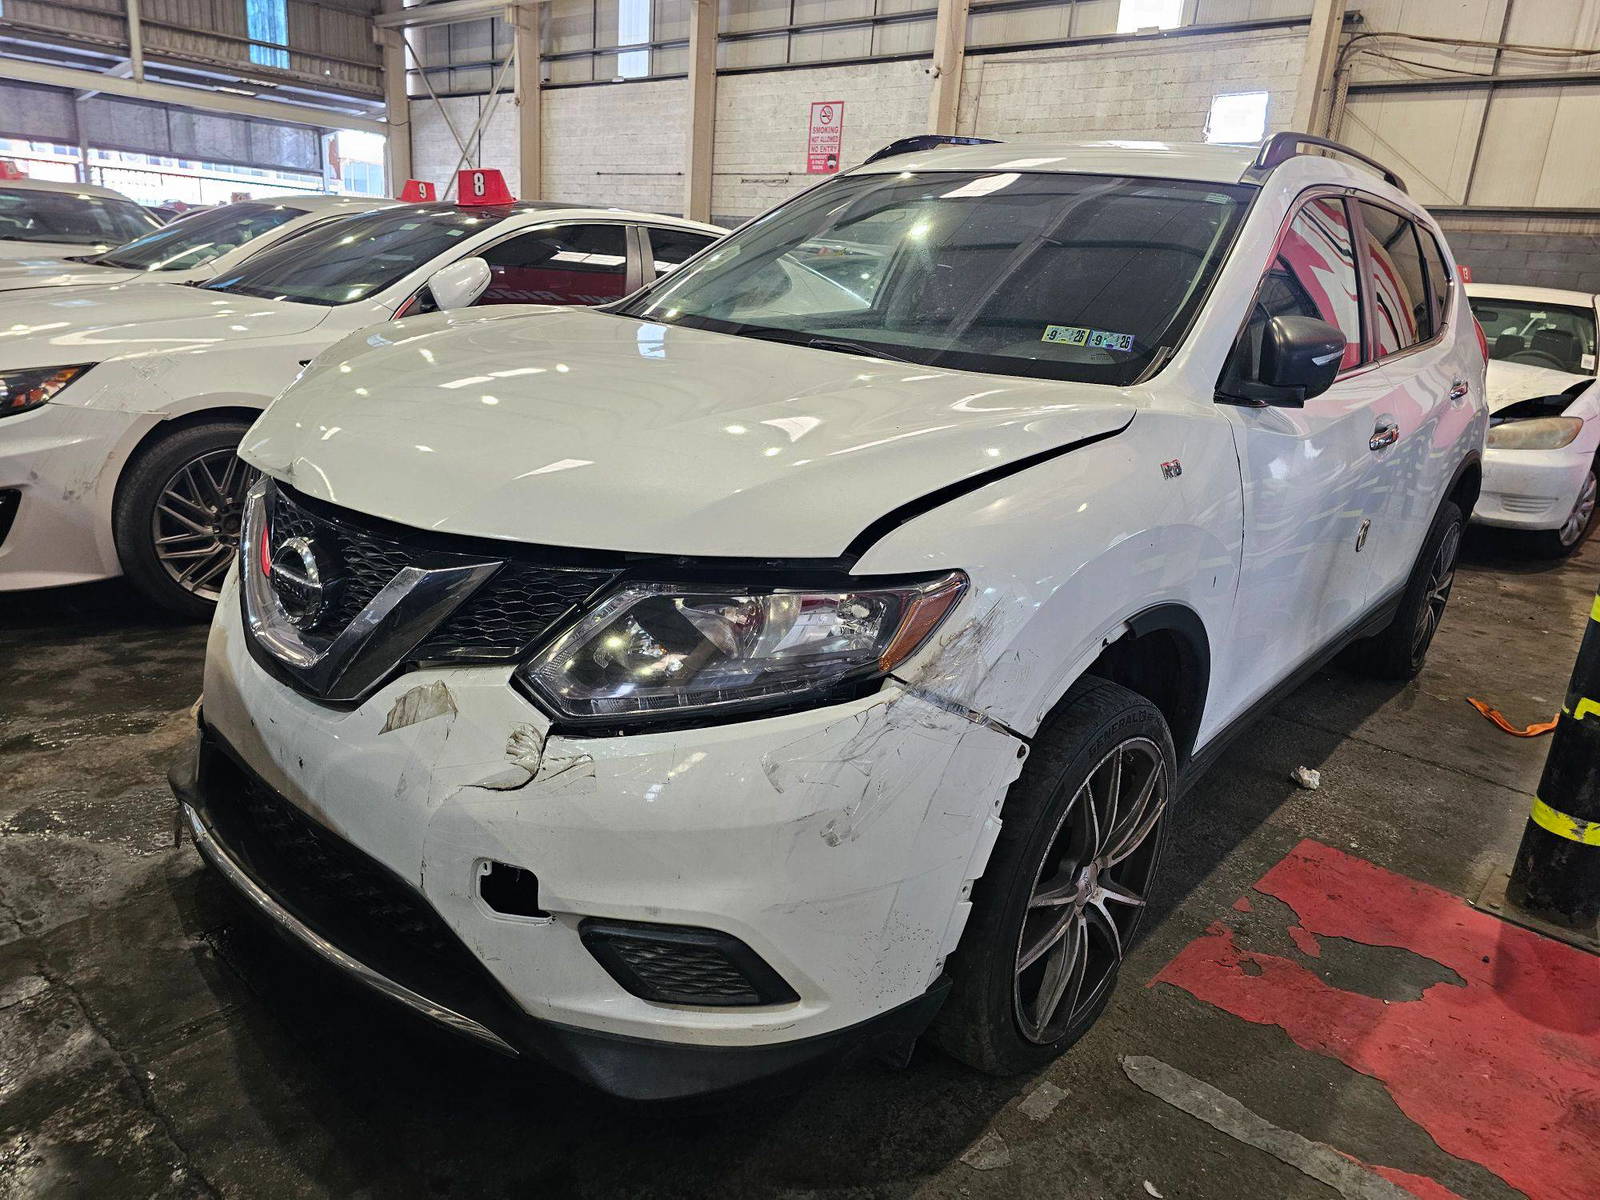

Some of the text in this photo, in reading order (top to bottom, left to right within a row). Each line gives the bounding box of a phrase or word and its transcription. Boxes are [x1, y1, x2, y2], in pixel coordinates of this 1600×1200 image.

[813, 126, 839, 134] SMOKING
[418, 182, 427, 199] 9
[473, 172, 485, 196] 8
[1073, 330, 1086, 342] 26
[1120, 336, 1130, 349] 26
